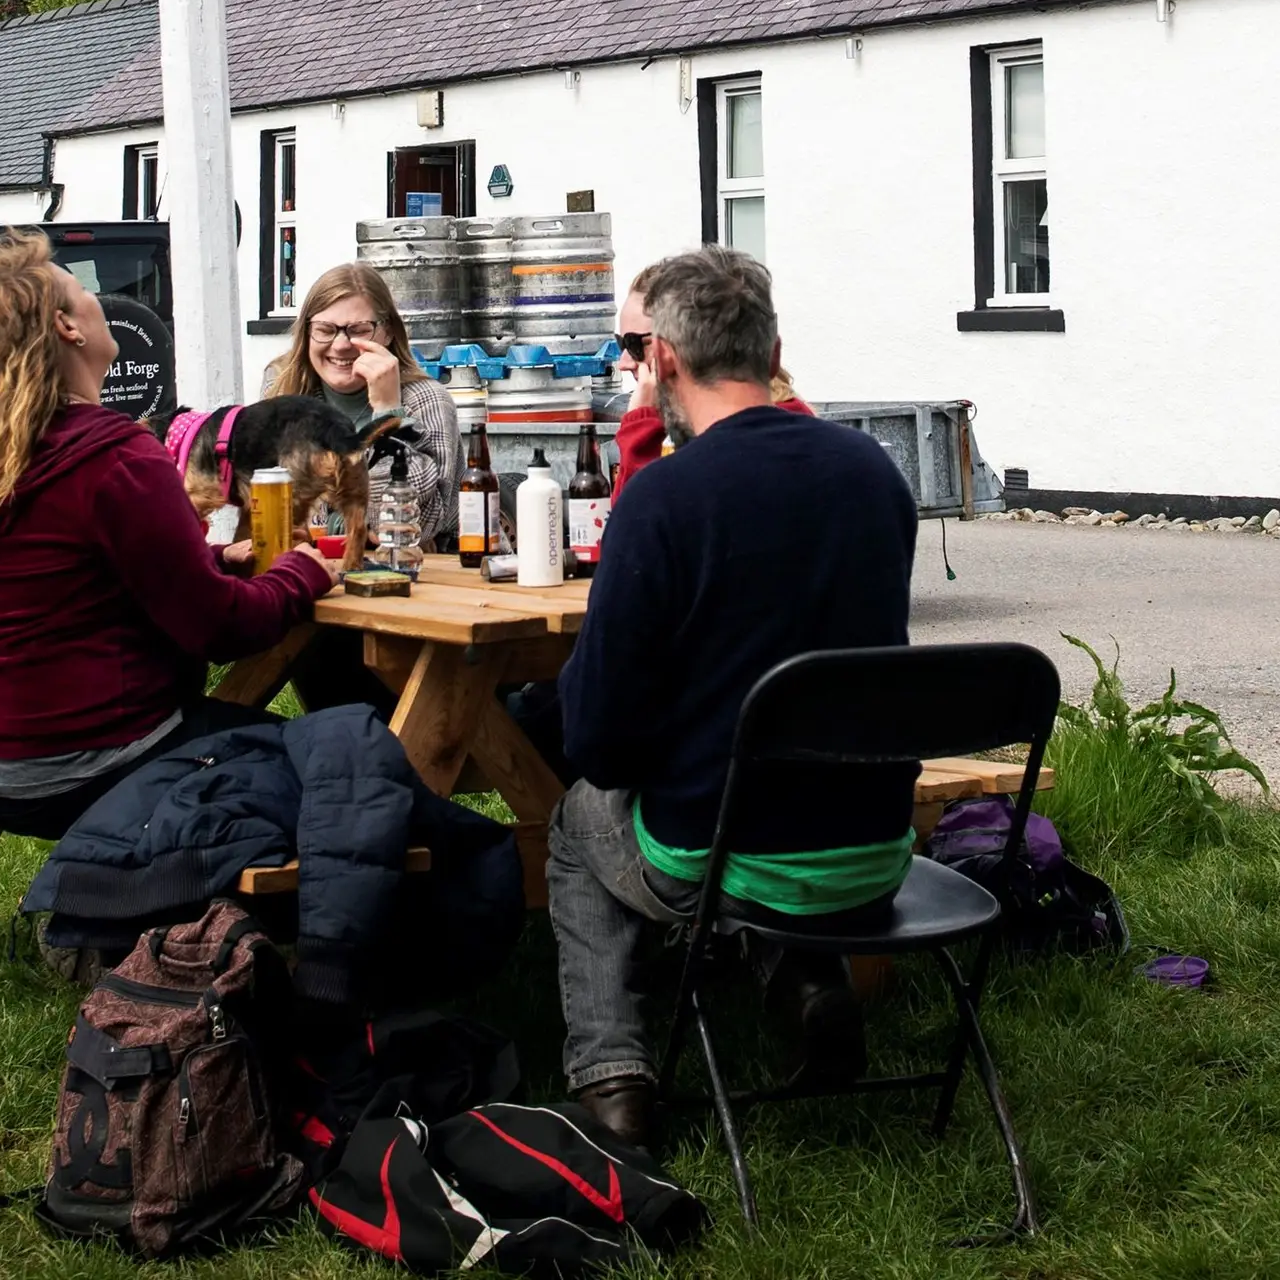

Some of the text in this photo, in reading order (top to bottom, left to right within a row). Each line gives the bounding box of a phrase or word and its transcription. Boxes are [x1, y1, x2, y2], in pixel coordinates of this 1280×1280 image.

[111, 320, 138, 331] mainland
[137, 328, 153, 347] Britain
[125, 361, 160, 379] Forge
[110, 385, 125, 394] fresh
[126, 382, 149, 392] seafood
[115, 394, 126, 402] live
[548, 496, 558, 567] openreach
